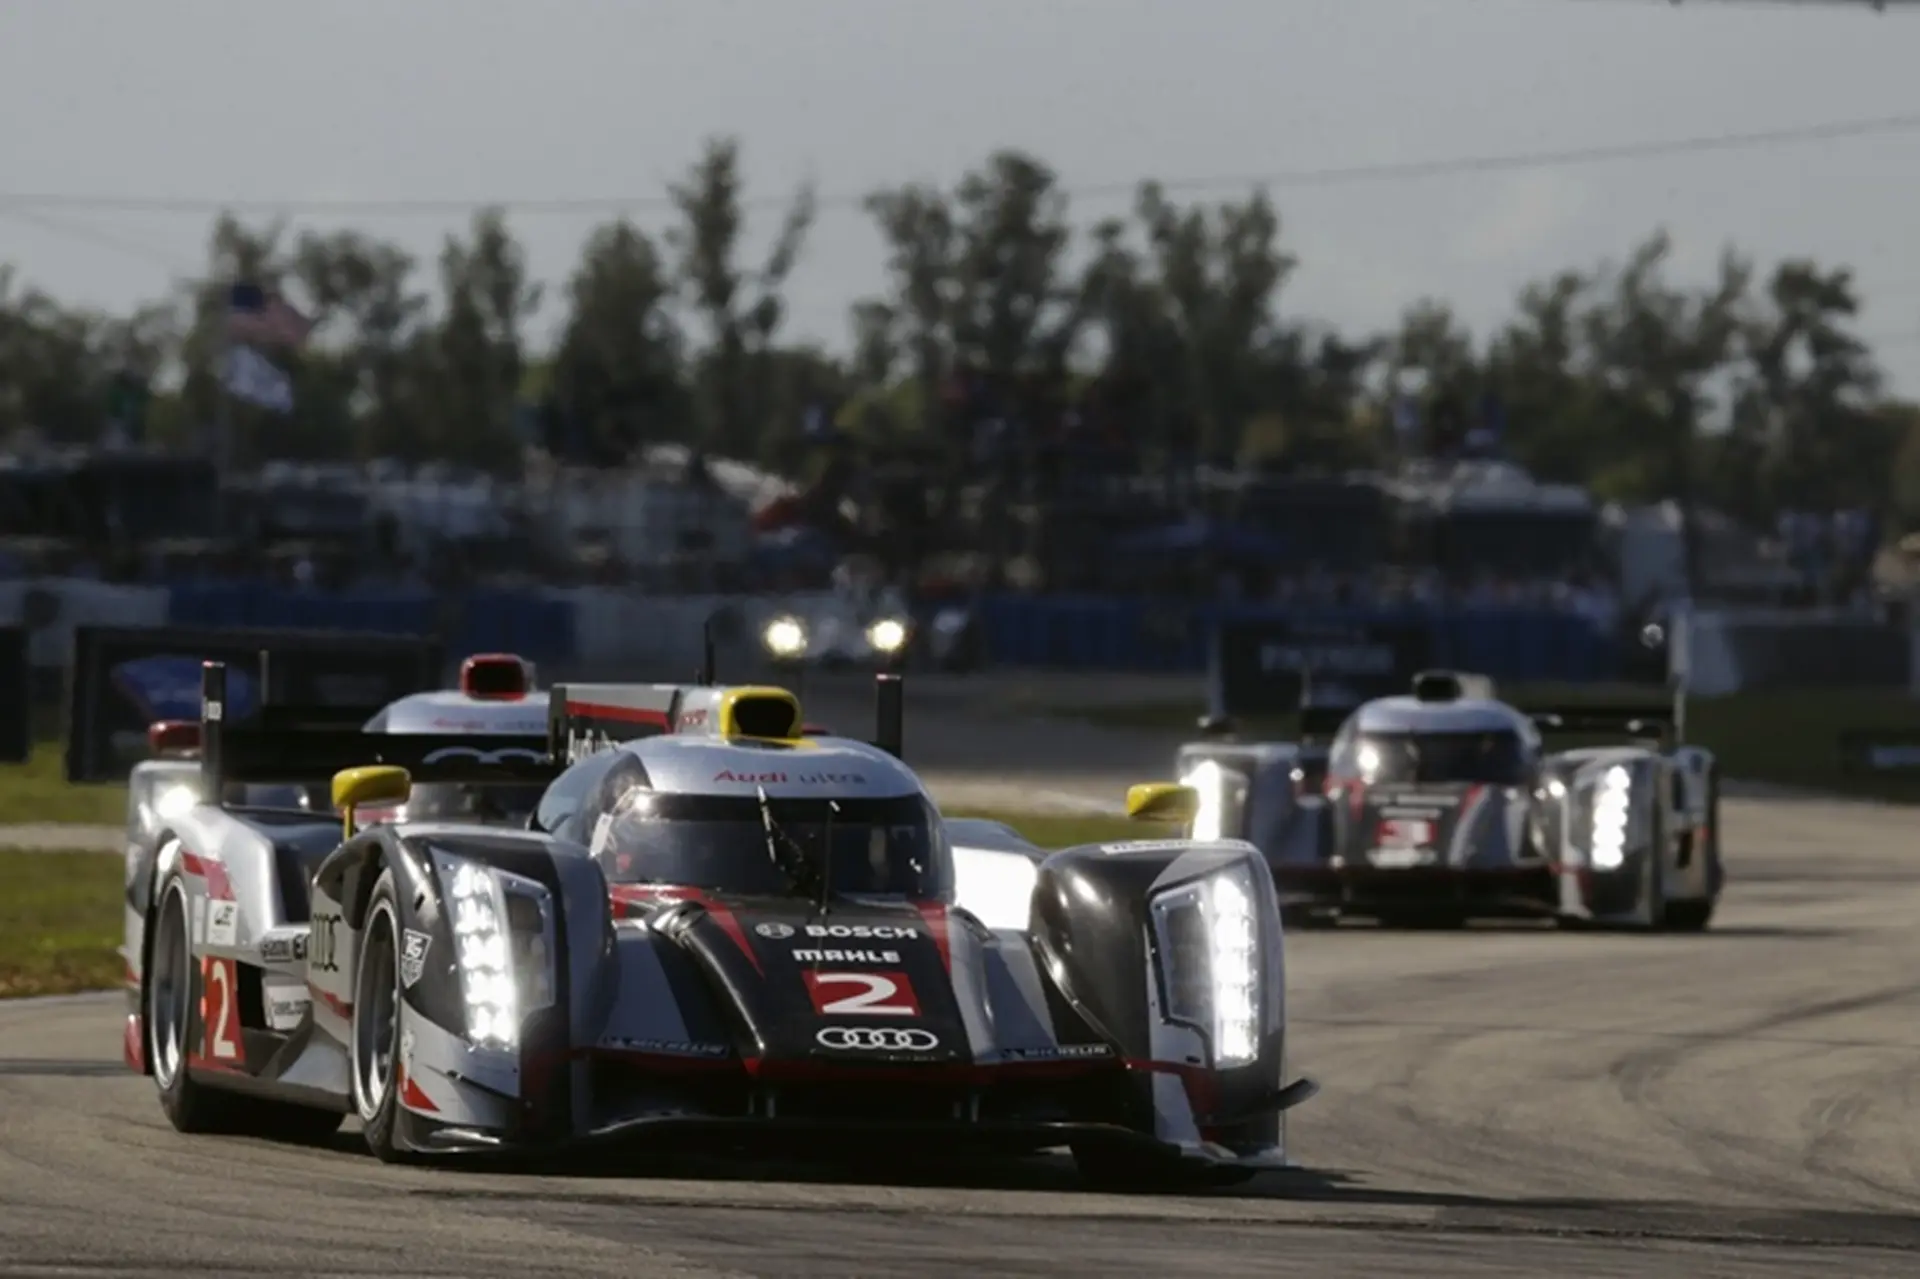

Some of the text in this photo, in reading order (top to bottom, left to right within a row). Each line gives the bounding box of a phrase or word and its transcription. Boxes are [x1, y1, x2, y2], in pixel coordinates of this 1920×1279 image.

[713, 769, 867, 784] Audi ultra
[805, 924, 918, 940] BOSCH
[791, 948, 901, 963] MAHLE
[816, 973, 914, 1015] 2
[211, 959, 236, 1058] 2
